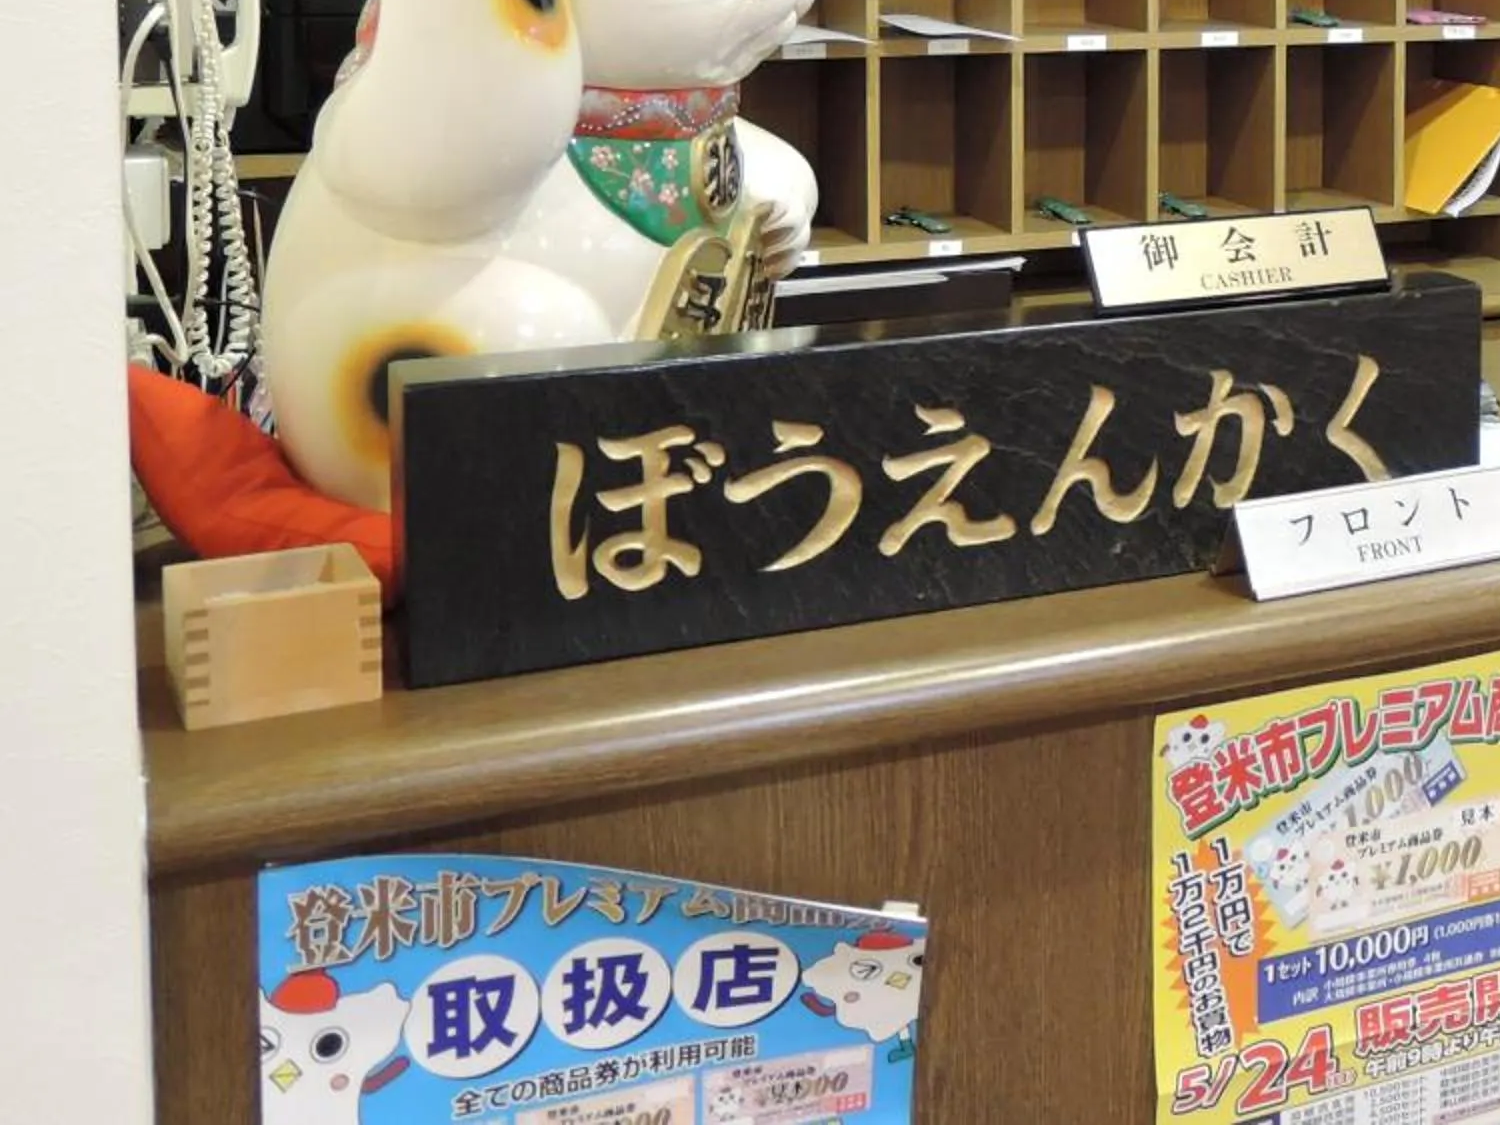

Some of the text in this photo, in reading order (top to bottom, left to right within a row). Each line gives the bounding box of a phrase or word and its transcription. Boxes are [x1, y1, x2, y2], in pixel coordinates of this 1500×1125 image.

[1139, 221, 1332, 271] 御会計
[1200, 265, 1294, 291] CASHIER
[550, 355, 1393, 602] ぼうえんかく
[1289, 486, 1471, 546] フロント
[1356, 535, 1425, 563] FRONT
[1460, 804, 1495, 826] 見本
[1210, 837, 1252, 954] 1万円で
[1171, 852, 1231, 1053] 1万2千円のお買物
[1316, 924, 1430, 975] 10,000円
[427, 943, 782, 1061] 取扱店
[453, 1034, 758, 1118] 全ての商品券が利用可能
